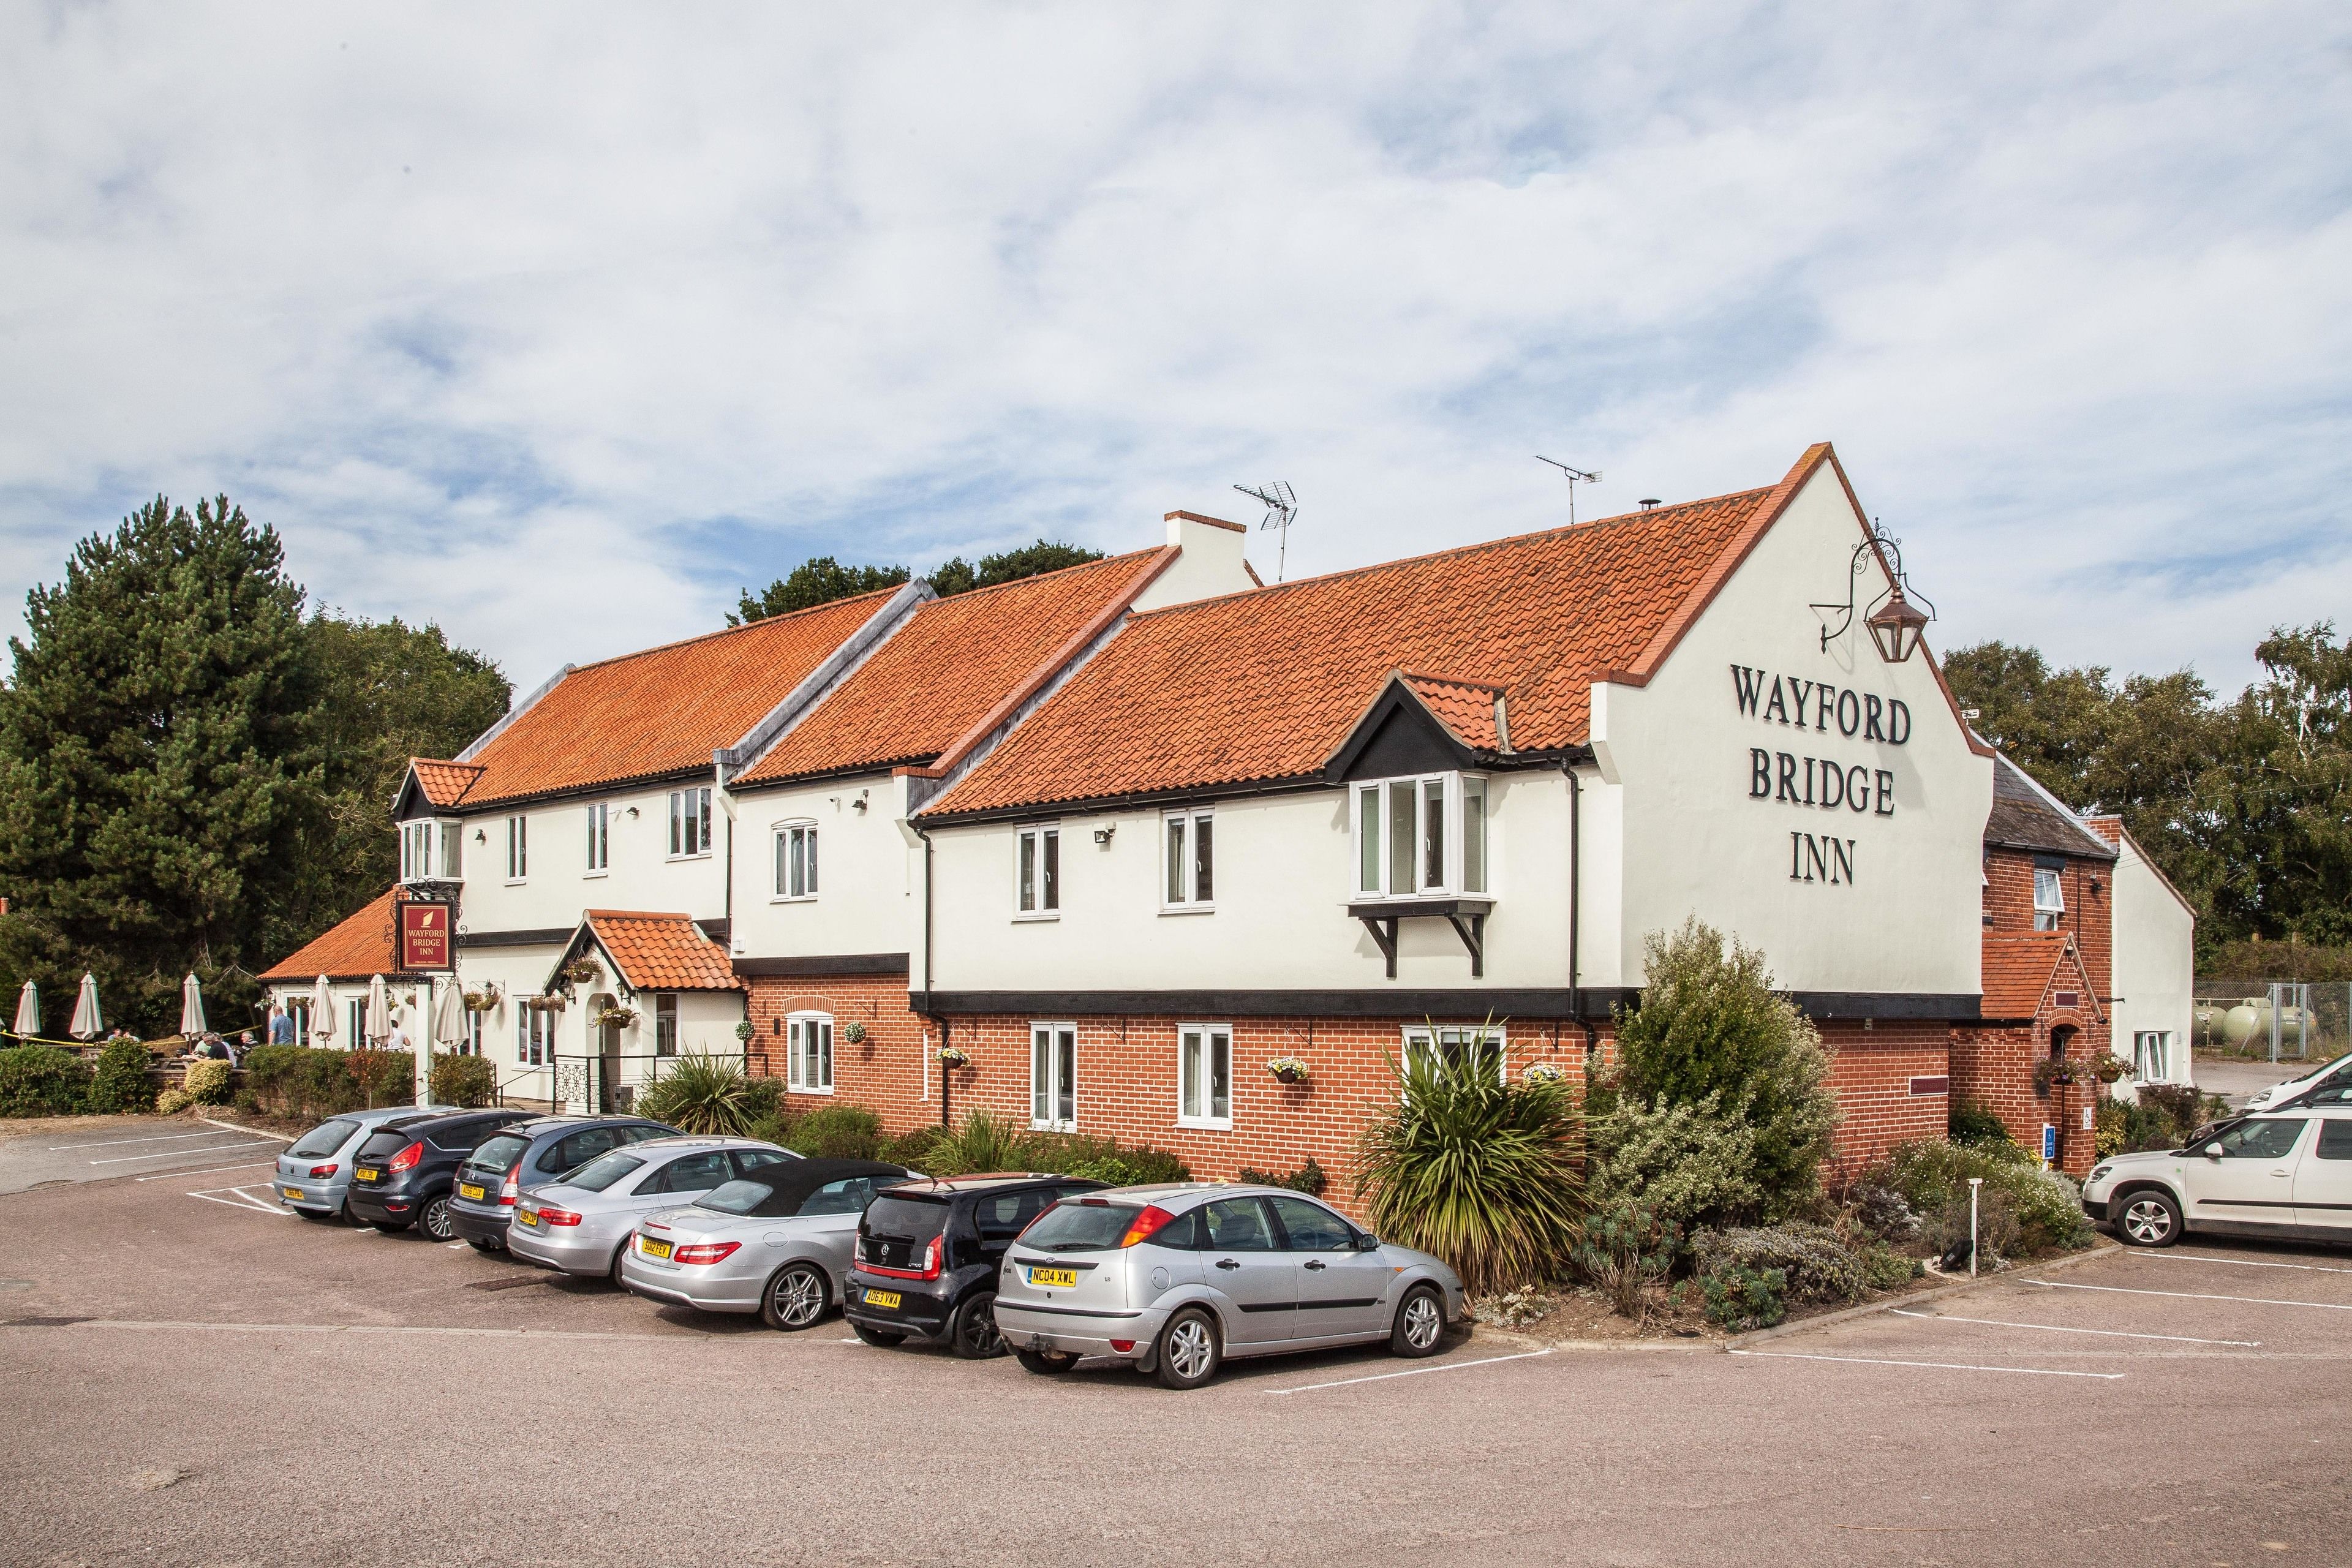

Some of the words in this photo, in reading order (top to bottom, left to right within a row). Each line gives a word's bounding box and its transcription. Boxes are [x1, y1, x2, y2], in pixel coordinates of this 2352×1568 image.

[1730, 663, 1911, 745] WAYFORD
[1749, 747, 1894, 816] BRIDGE
[1790, 831, 1856, 884] INN
[644, 1239, 656, 1252] SO12
[1033, 1268, 1055, 1282] NC04
[1057, 1271, 1074, 1284] XWL
[867, 1290, 884, 1302] AO63
[884, 1293, 899, 1305] VWA
